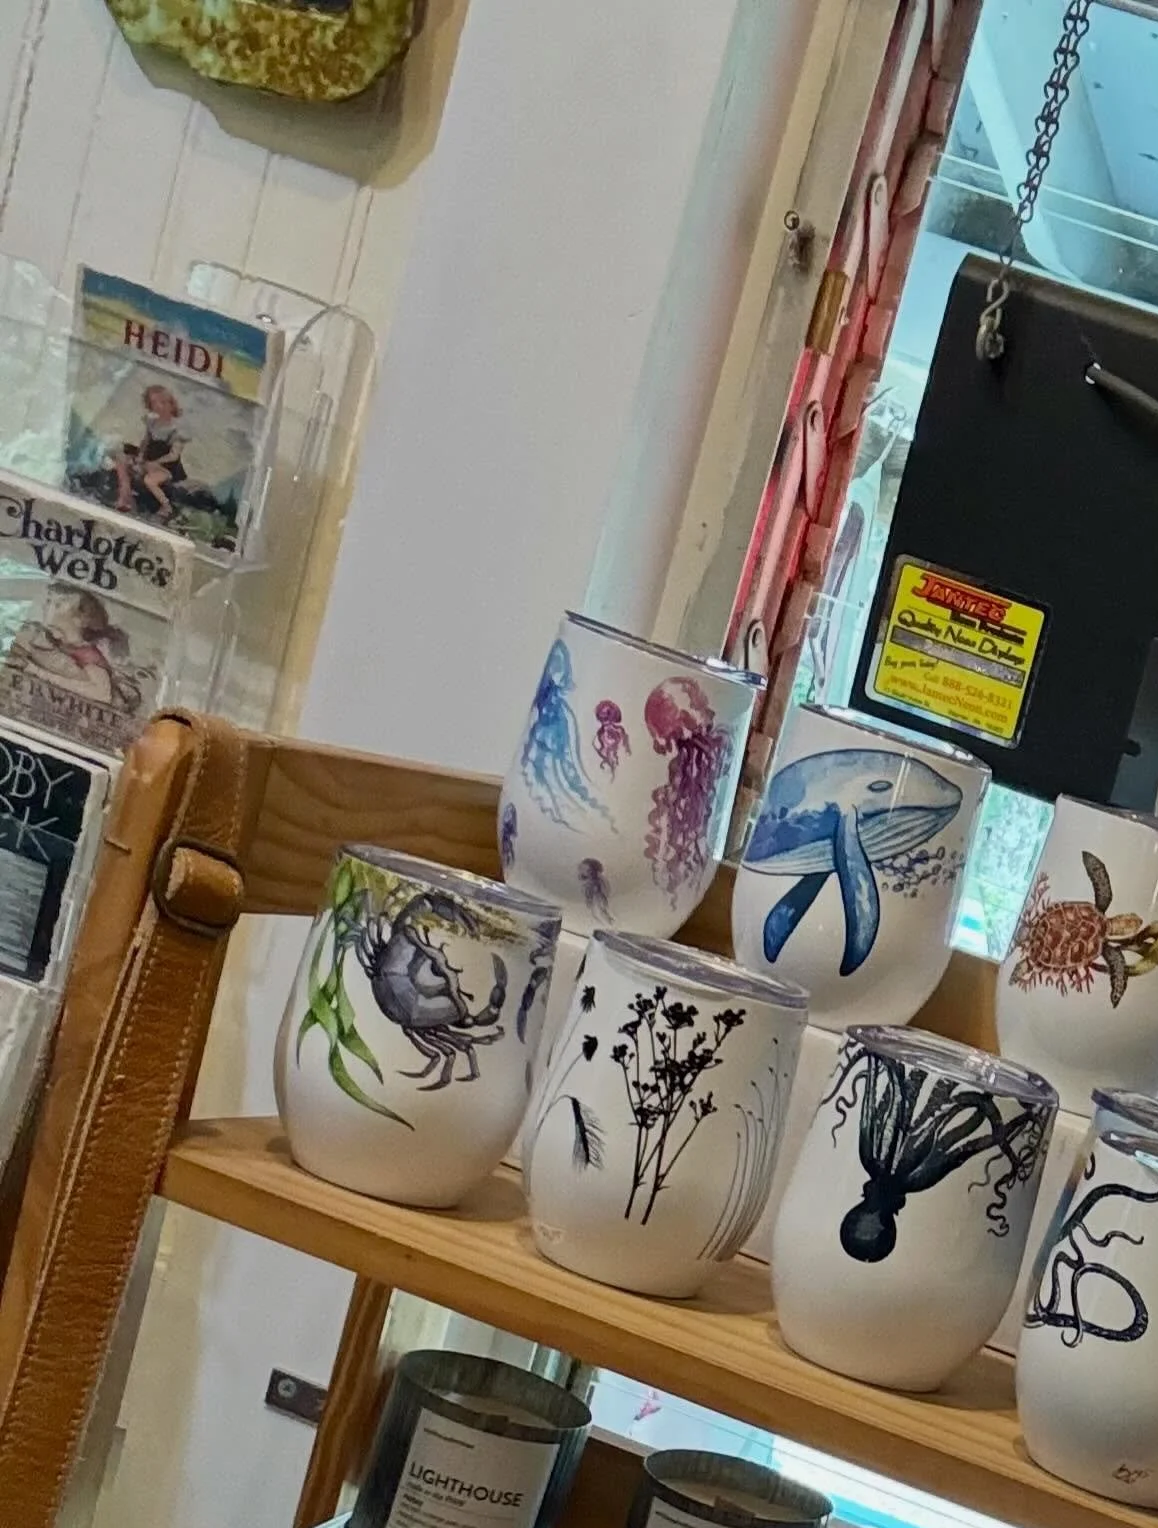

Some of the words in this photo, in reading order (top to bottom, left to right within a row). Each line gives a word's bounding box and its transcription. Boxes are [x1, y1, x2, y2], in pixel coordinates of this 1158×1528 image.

[123, 319, 226, 379] HEIDI
[0, 495, 174, 588] Charlotte's
[30, 543, 119, 591] Web
[408, 1461, 525, 1508] LIGHTHOUSE
